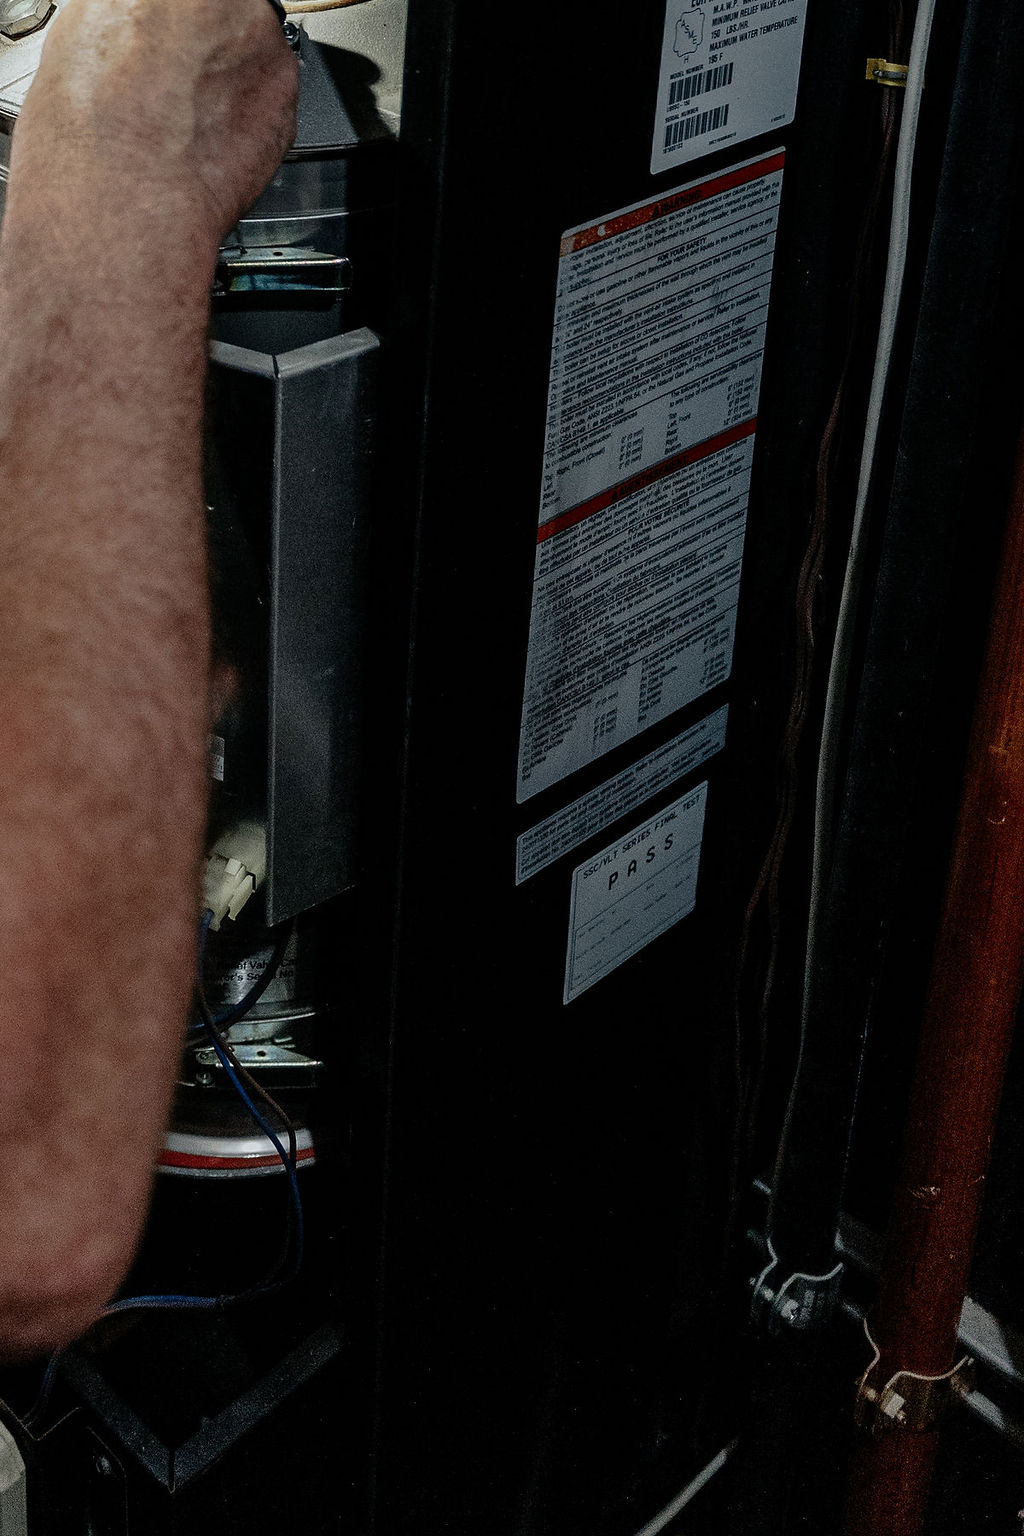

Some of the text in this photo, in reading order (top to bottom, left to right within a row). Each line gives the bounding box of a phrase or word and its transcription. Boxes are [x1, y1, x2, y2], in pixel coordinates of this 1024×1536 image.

[712, 11, 739, 27] MINIMUM
[740, 5, 759, 17] RELIEF
[760, 0, 777, 11] VALVE
[709, 16, 798, 52] MAXIMUM WATER TEMPERATURE
[658, 237, 706, 262] FOR YOUR SAFETY
[583, 793, 701, 880] SSC/VLT SERIES FINAL TEST
[608, 831, 675, 892] PASS
